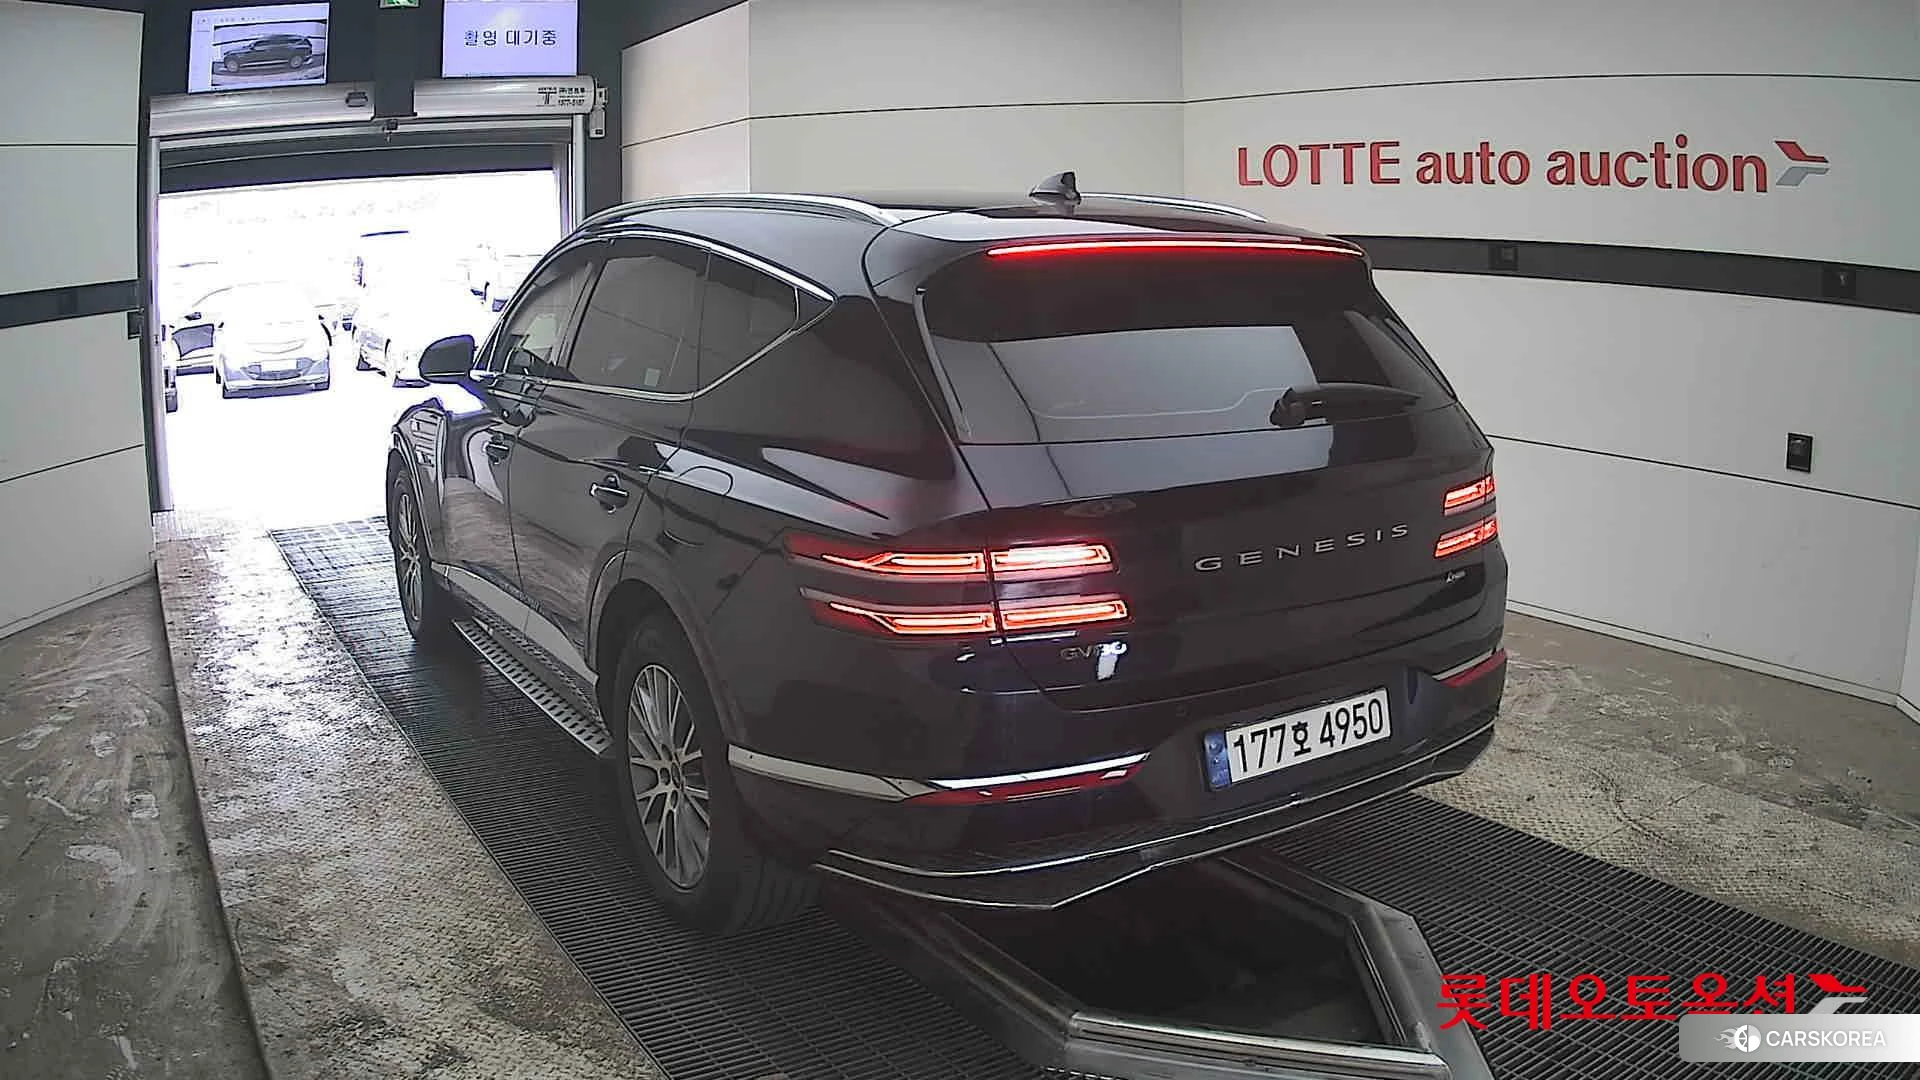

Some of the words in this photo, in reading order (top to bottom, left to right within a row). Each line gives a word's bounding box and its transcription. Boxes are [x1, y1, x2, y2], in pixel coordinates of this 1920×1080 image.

[506, 30, 557, 46] 대기중
[1237, 140, 1401, 187] LOTTE
[1416, 140, 1531, 187] auto
[1545, 134, 1768, 193] auction
[1194, 523, 1410, 573] GENESIS
[1232, 720, 1312, 774] 177호
[1319, 698, 1385, 749] 4950
